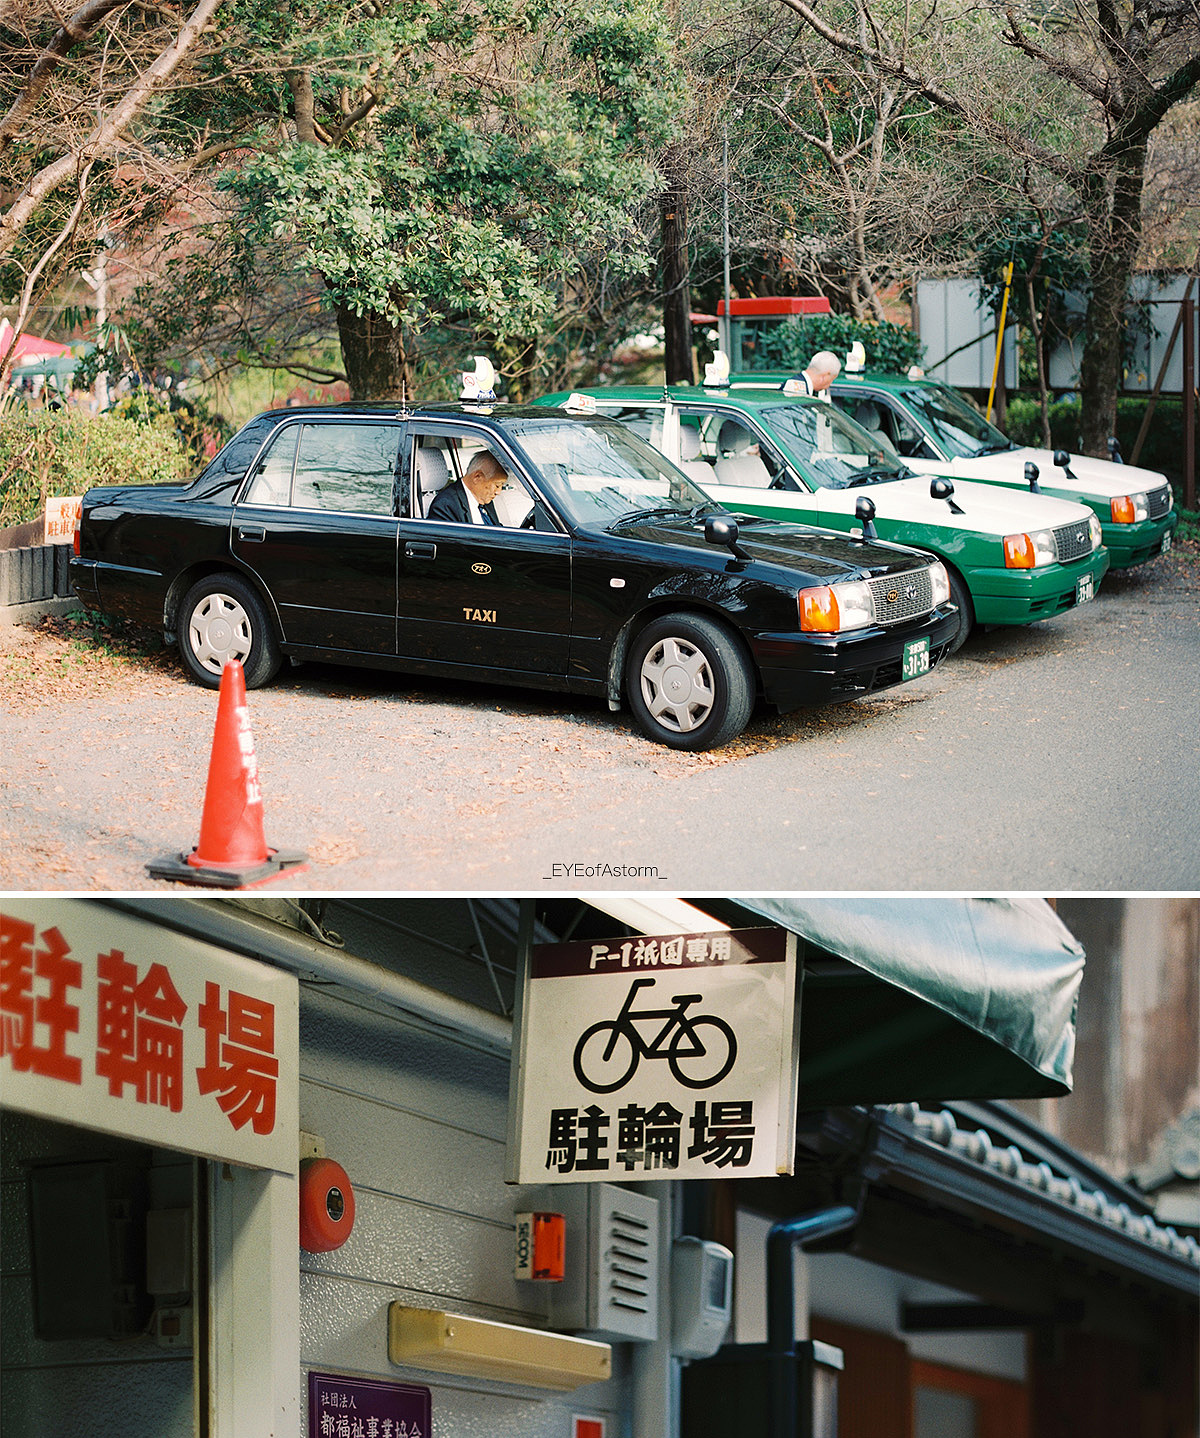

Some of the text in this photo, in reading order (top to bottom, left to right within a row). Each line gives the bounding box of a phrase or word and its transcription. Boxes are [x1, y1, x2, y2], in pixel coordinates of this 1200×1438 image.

[463, 607, 497, 623] TAXI
[0, 913, 279, 1136] 駐輪場
[545, 1100, 756, 1174] 駐輪場
[518, 1222, 530, 1269] SECOM
[320, 1391, 358, 1410] 社団法人
